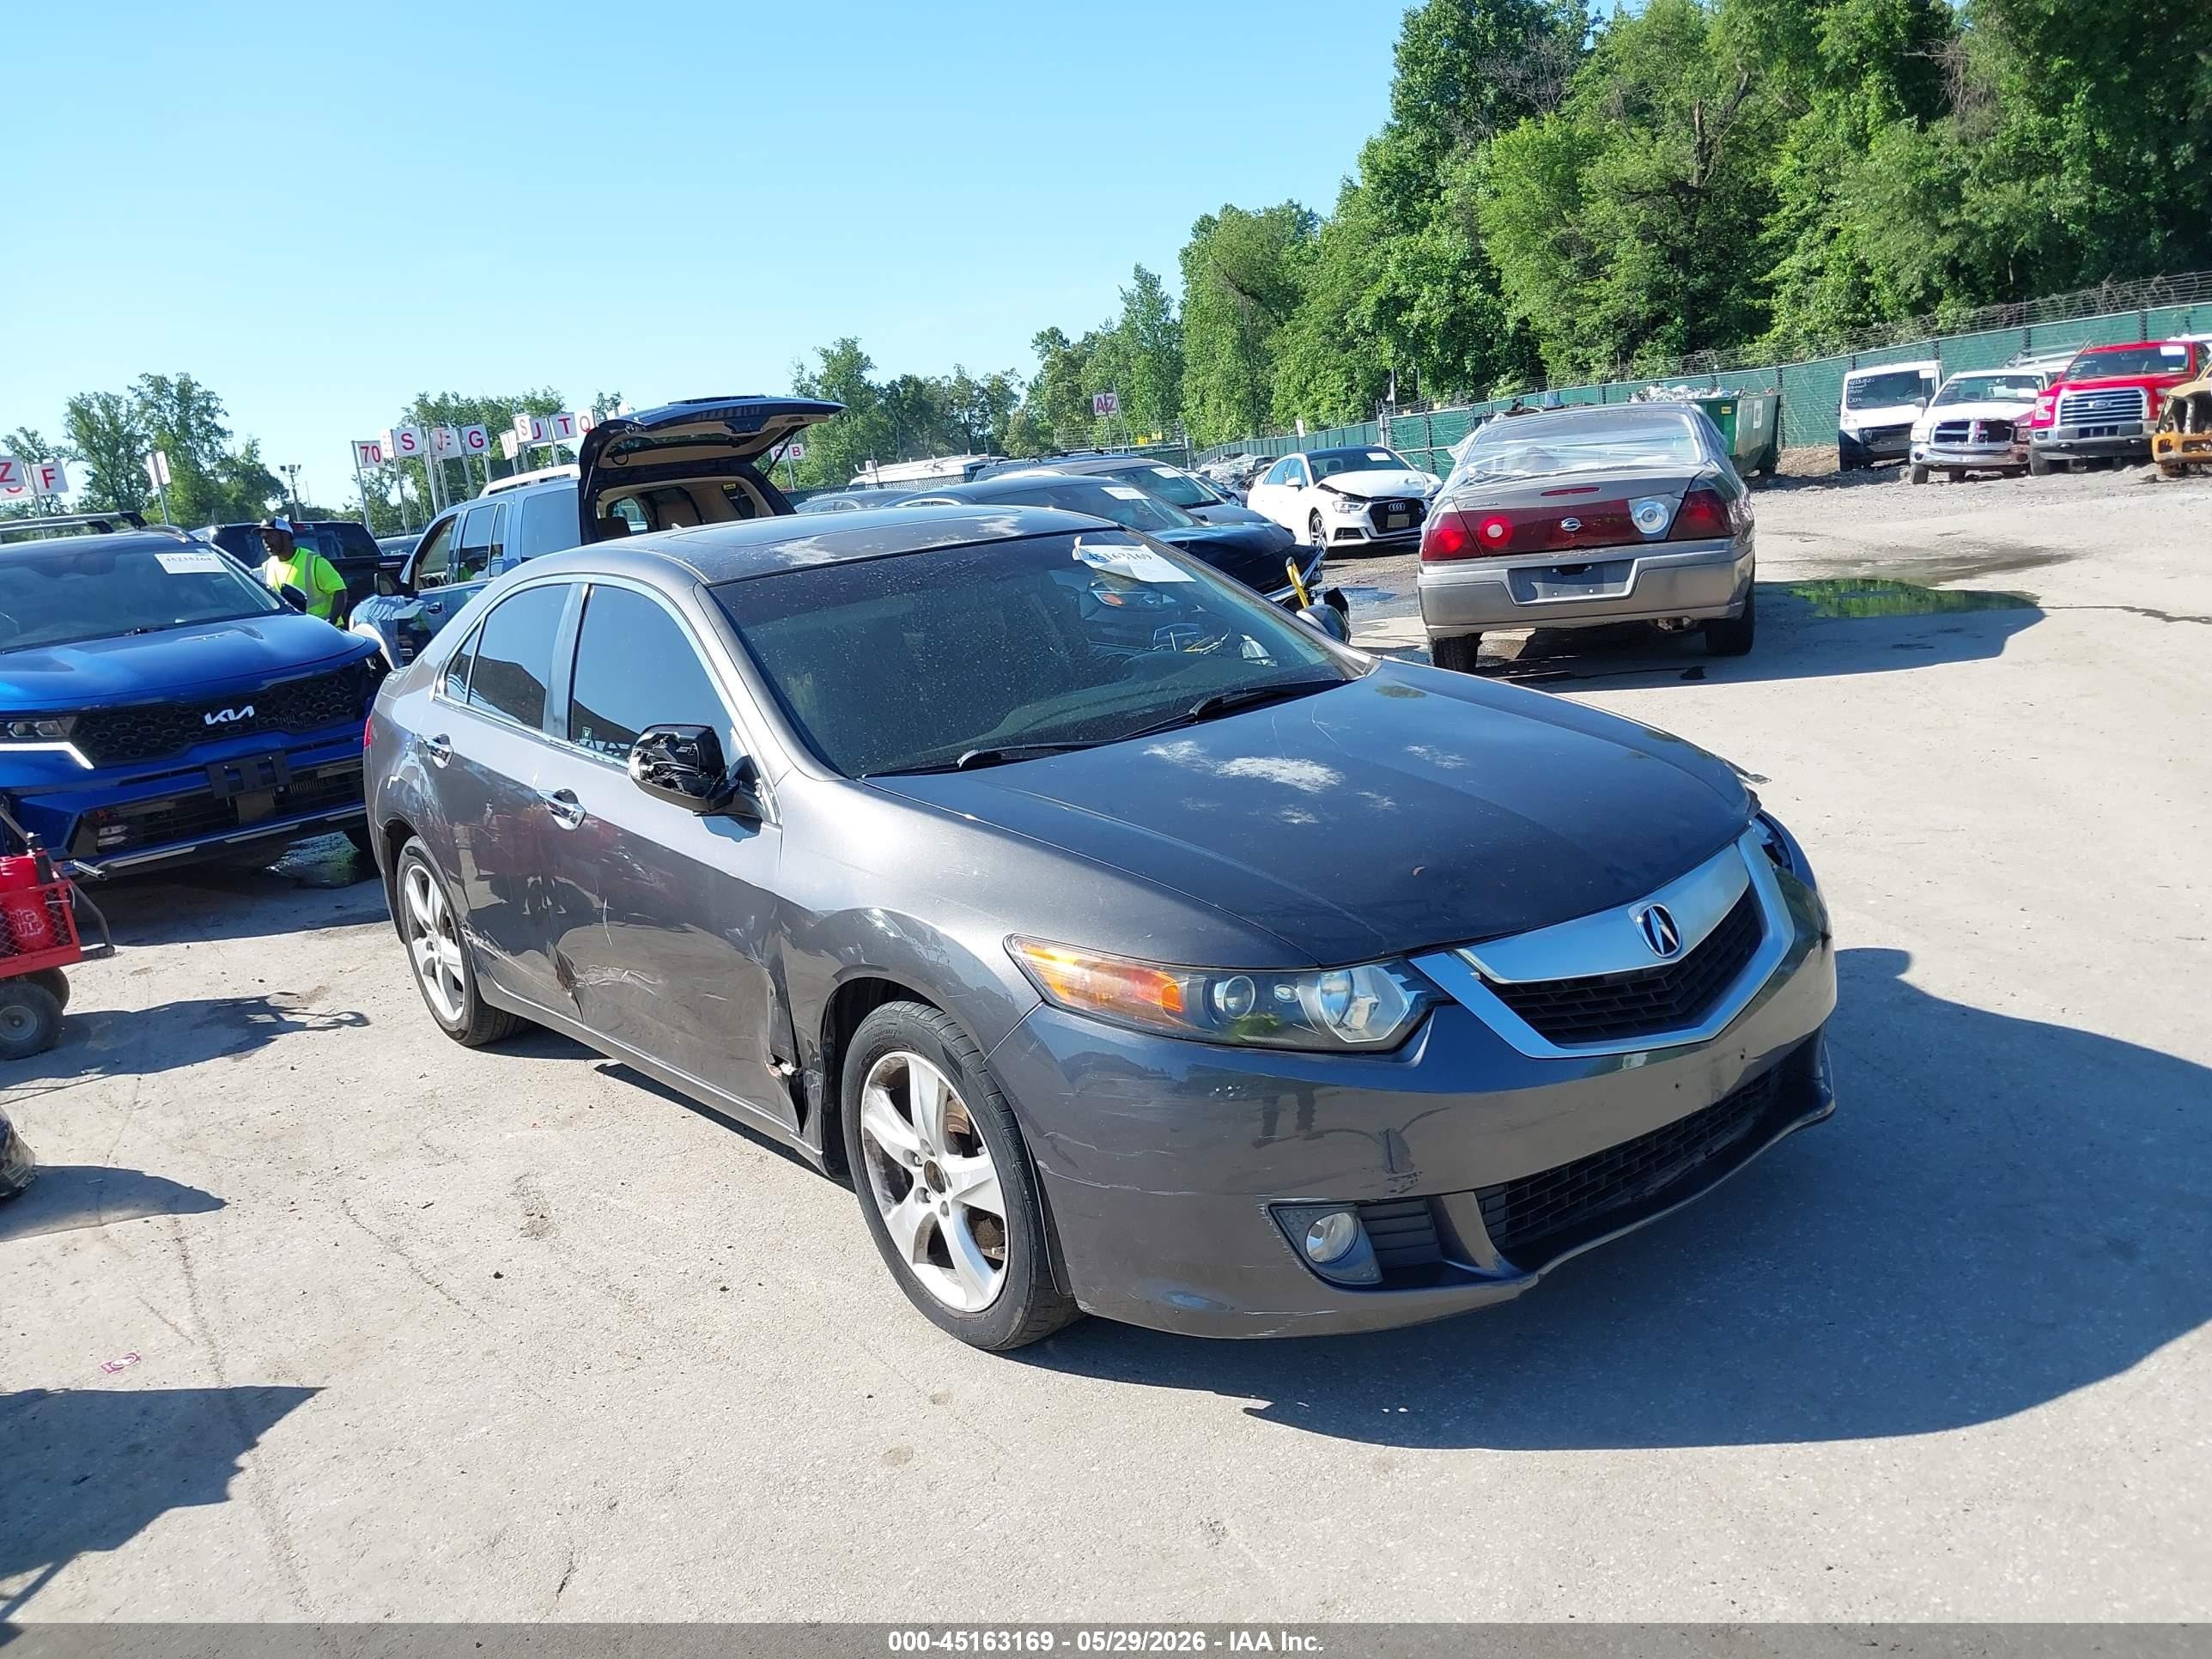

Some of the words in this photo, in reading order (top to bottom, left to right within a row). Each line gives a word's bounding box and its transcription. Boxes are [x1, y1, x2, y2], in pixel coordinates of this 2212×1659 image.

[519, 419, 527, 436] S
[532, 422, 542, 440] J
[558, 417, 571, 434] T
[580, 416, 592, 433] Q
[400, 433, 416, 451] S
[468, 430, 484, 448] G
[360, 445, 380, 463] 70
[793, 447, 801, 456] B
[0, 462, 16, 483] Z
[41, 468, 56, 489] F
